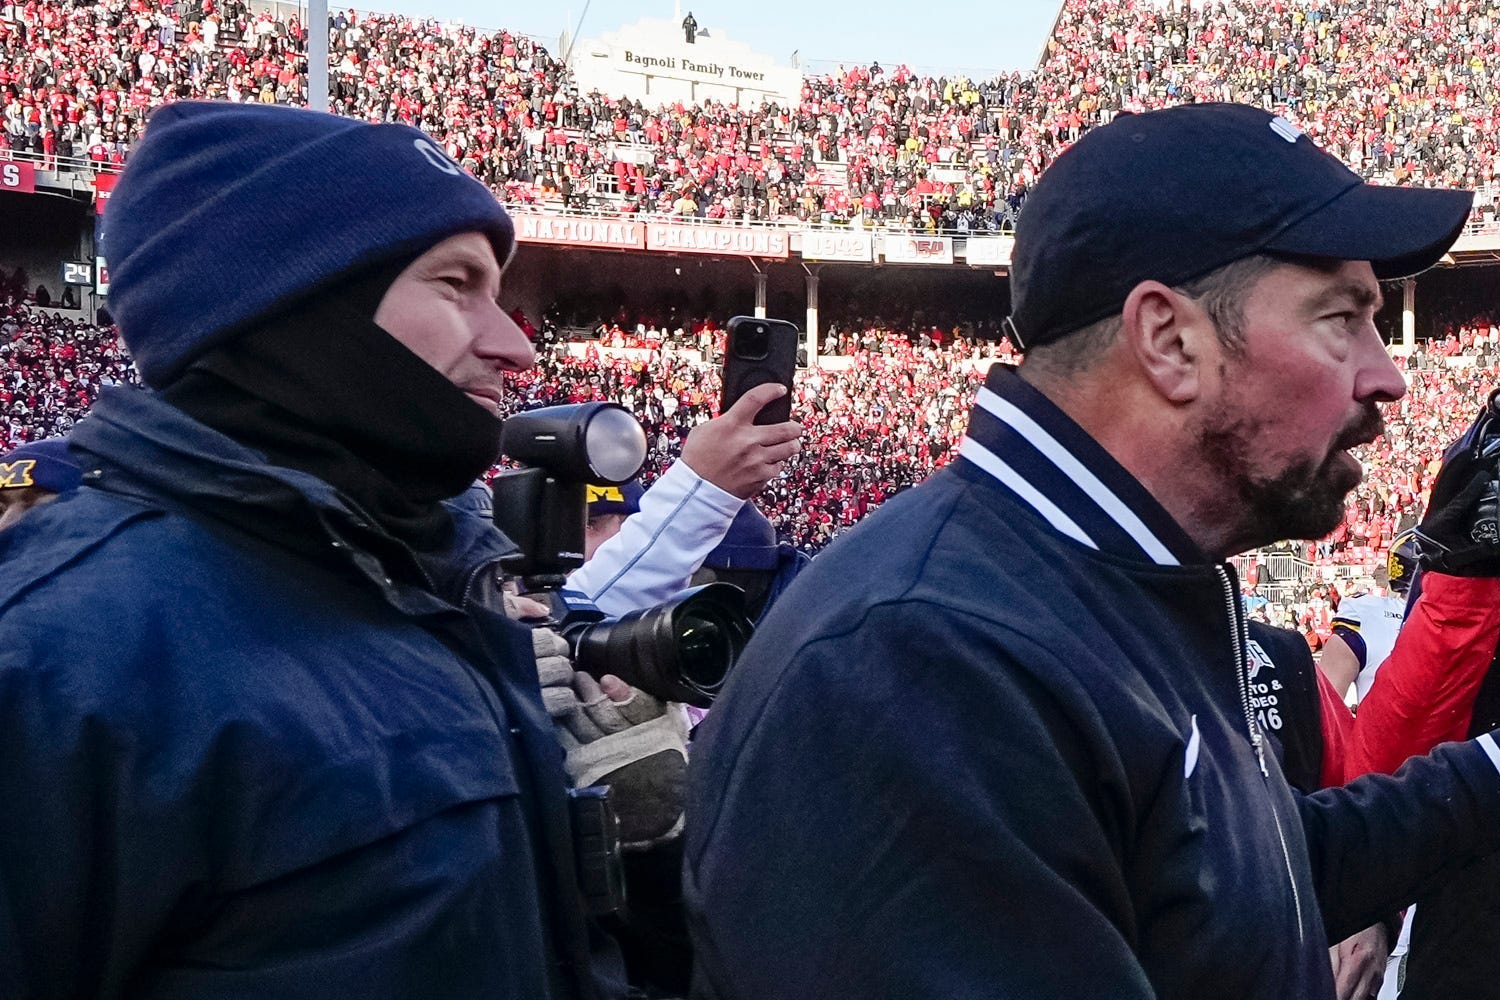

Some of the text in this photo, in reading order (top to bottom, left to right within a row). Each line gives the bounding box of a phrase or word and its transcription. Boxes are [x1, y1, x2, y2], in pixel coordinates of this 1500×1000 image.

[624, 50, 765, 81] Bagnoli Family Tower
[523, 217, 784, 254] NATIONAL CHAMPIONS
[64, 262, 91, 283] 24
[0, 459, 36, 488] M
[586, 484, 624, 503] M
[1272, 680, 1283, 690] &
[1251, 695, 1278, 708] DEO
